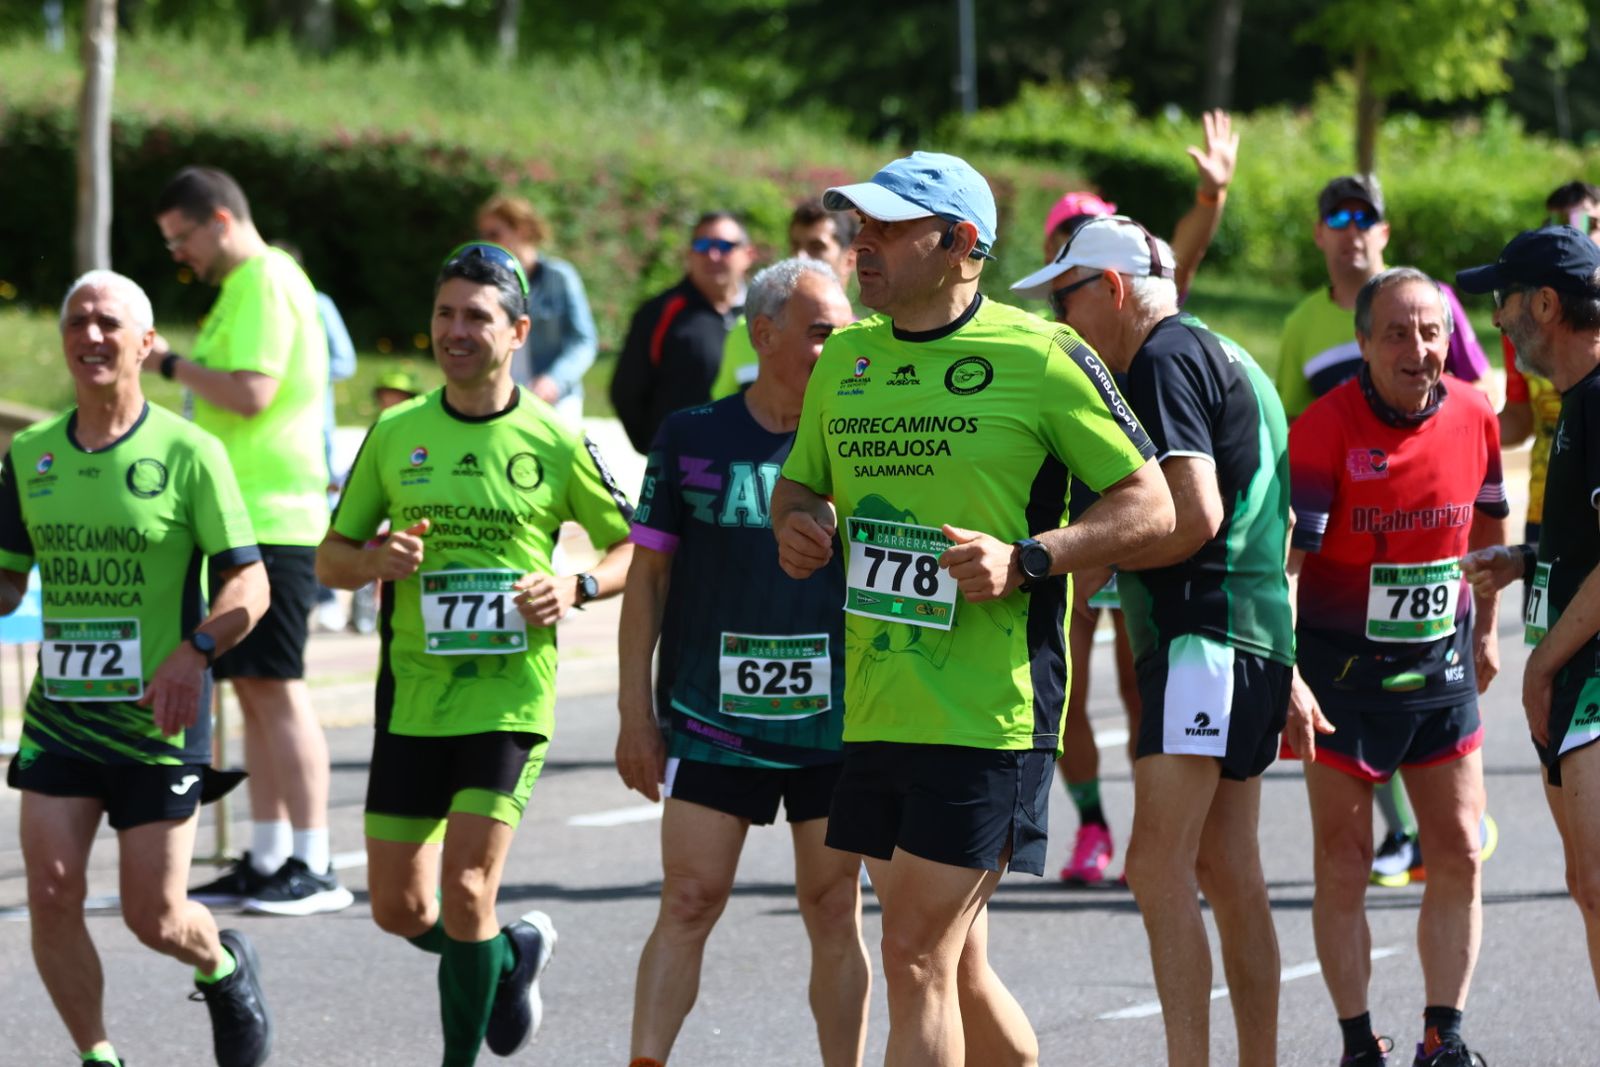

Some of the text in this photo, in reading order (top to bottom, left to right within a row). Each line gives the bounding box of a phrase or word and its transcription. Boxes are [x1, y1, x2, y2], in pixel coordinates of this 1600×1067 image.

[1084, 355, 1138, 433] CARBAJOSA
[828, 416, 979, 435] CORRECAMINOS
[838, 439, 951, 458] CARBAJOSA
[854, 464, 934, 477] SALAMANCA
[1352, 503, 1473, 534] DCabrerizo
[878, 533, 928, 550] CARRERA
[42, 557, 146, 586] ARBAJOSA
[864, 546, 939, 597] 778
[44, 591, 143, 607] ALAMANCA
[437, 594, 505, 630] 771
[1387, 585, 1449, 620] 789
[54, 643, 124, 677] 772
[1445, 665, 1465, 683] MSC
[737, 659, 813, 695] 625
[1184, 728, 1220, 736] VIATOR
